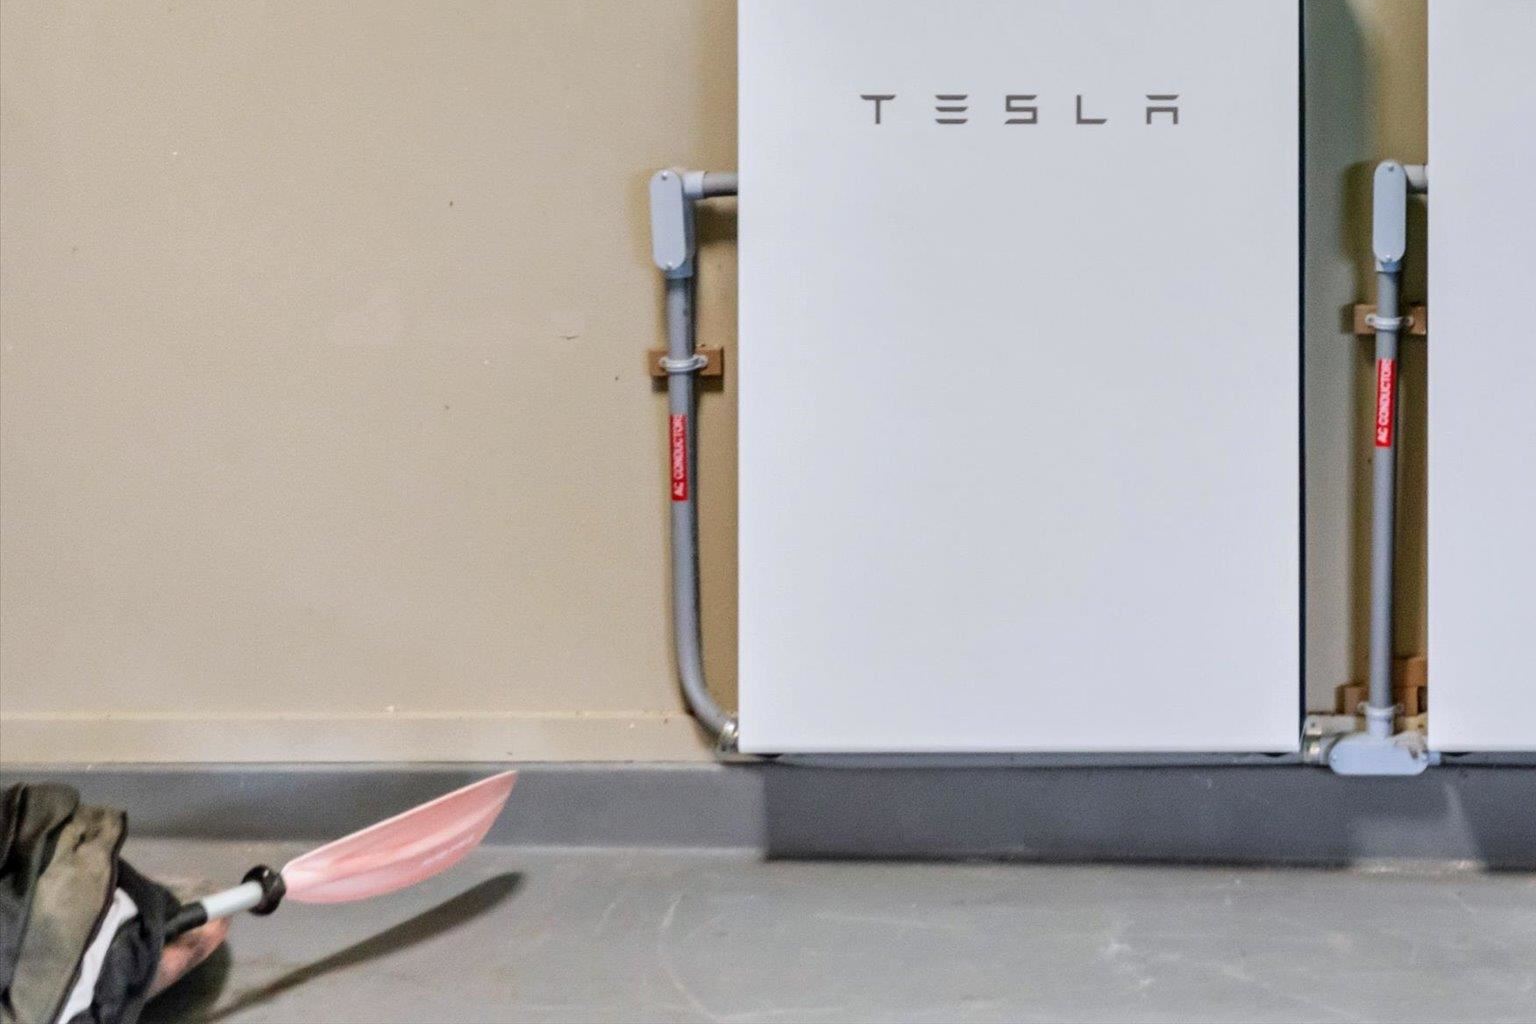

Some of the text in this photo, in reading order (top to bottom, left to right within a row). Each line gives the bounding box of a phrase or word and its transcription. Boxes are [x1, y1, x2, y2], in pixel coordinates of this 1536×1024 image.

[860, 95, 1179, 125] TESLA
[1377, 426, 1388, 443] AC
[673, 481, 684, 496] AC
